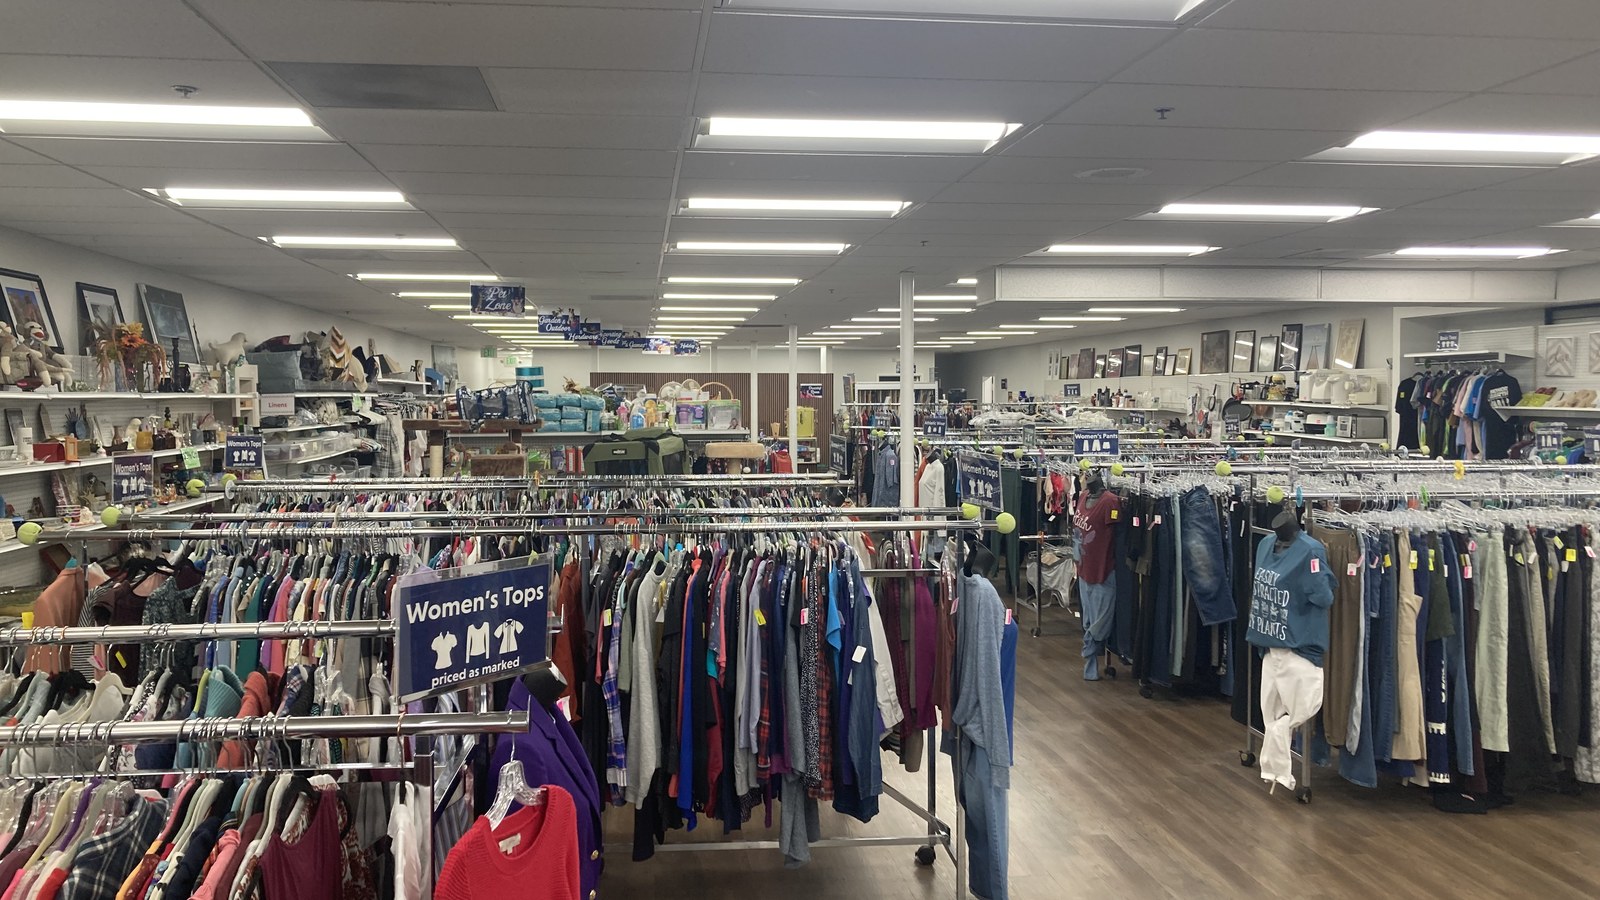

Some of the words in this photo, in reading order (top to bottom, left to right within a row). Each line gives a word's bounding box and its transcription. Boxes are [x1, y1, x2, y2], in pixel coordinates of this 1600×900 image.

[485, 286, 507, 300] Pet
[485, 299, 512, 310] Zone
[539, 316, 561, 325] Garden
[546, 323, 571, 332] Outdoor
[568, 332, 600, 341] Hardware
[601, 337, 620, 346] Goods
[227, 440, 250, 448] Women's
[250, 440, 262, 449] Tops
[115, 463, 139, 474] Women's
[139, 462, 152, 475] Tops
[962, 462, 985, 476] Women's
[985, 466, 998, 480] Tops
[1253, 580, 1290, 608] STRACTED
[405, 590, 499, 624] Women's
[502, 585, 544, 607] Tops
[1256, 616, 1288, 641] PLANTS
[431, 669, 466, 689] priced
[468, 669, 480, 679] as
[481, 656, 520, 675] marked
